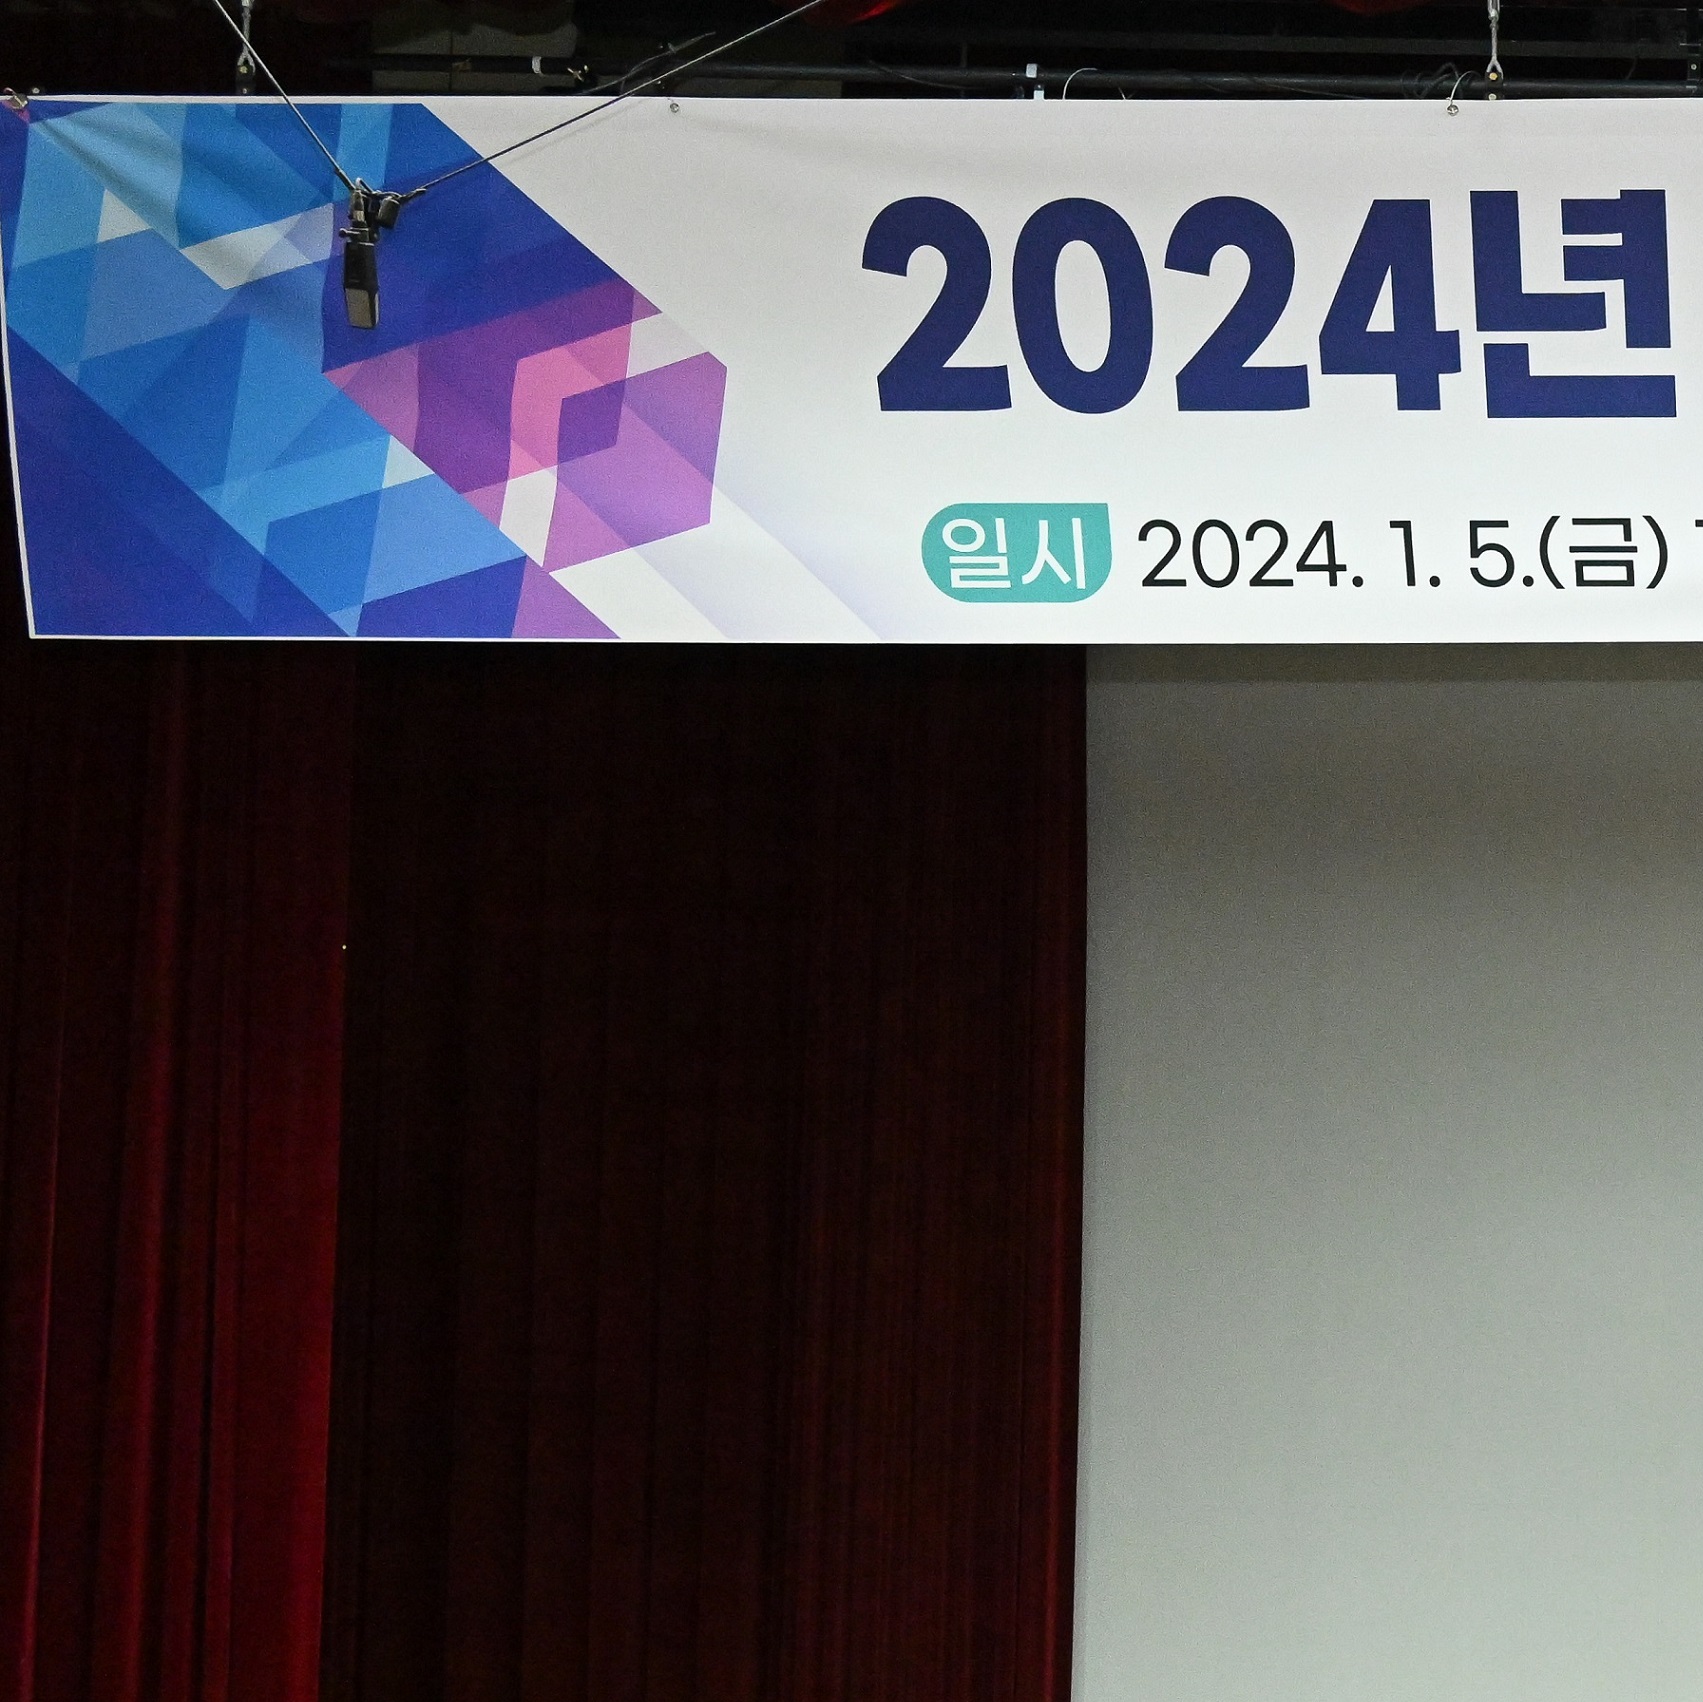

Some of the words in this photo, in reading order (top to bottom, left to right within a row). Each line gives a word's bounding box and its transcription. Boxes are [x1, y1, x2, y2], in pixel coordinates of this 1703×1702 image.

[860, 187, 1678, 419] 2024년
[943, 516, 1087, 590] 일시
[1137, 517, 1364, 589] 2024.
[1388, 519, 1441, 588] 1.
[1468, 514, 1668, 590] 5.(금)
